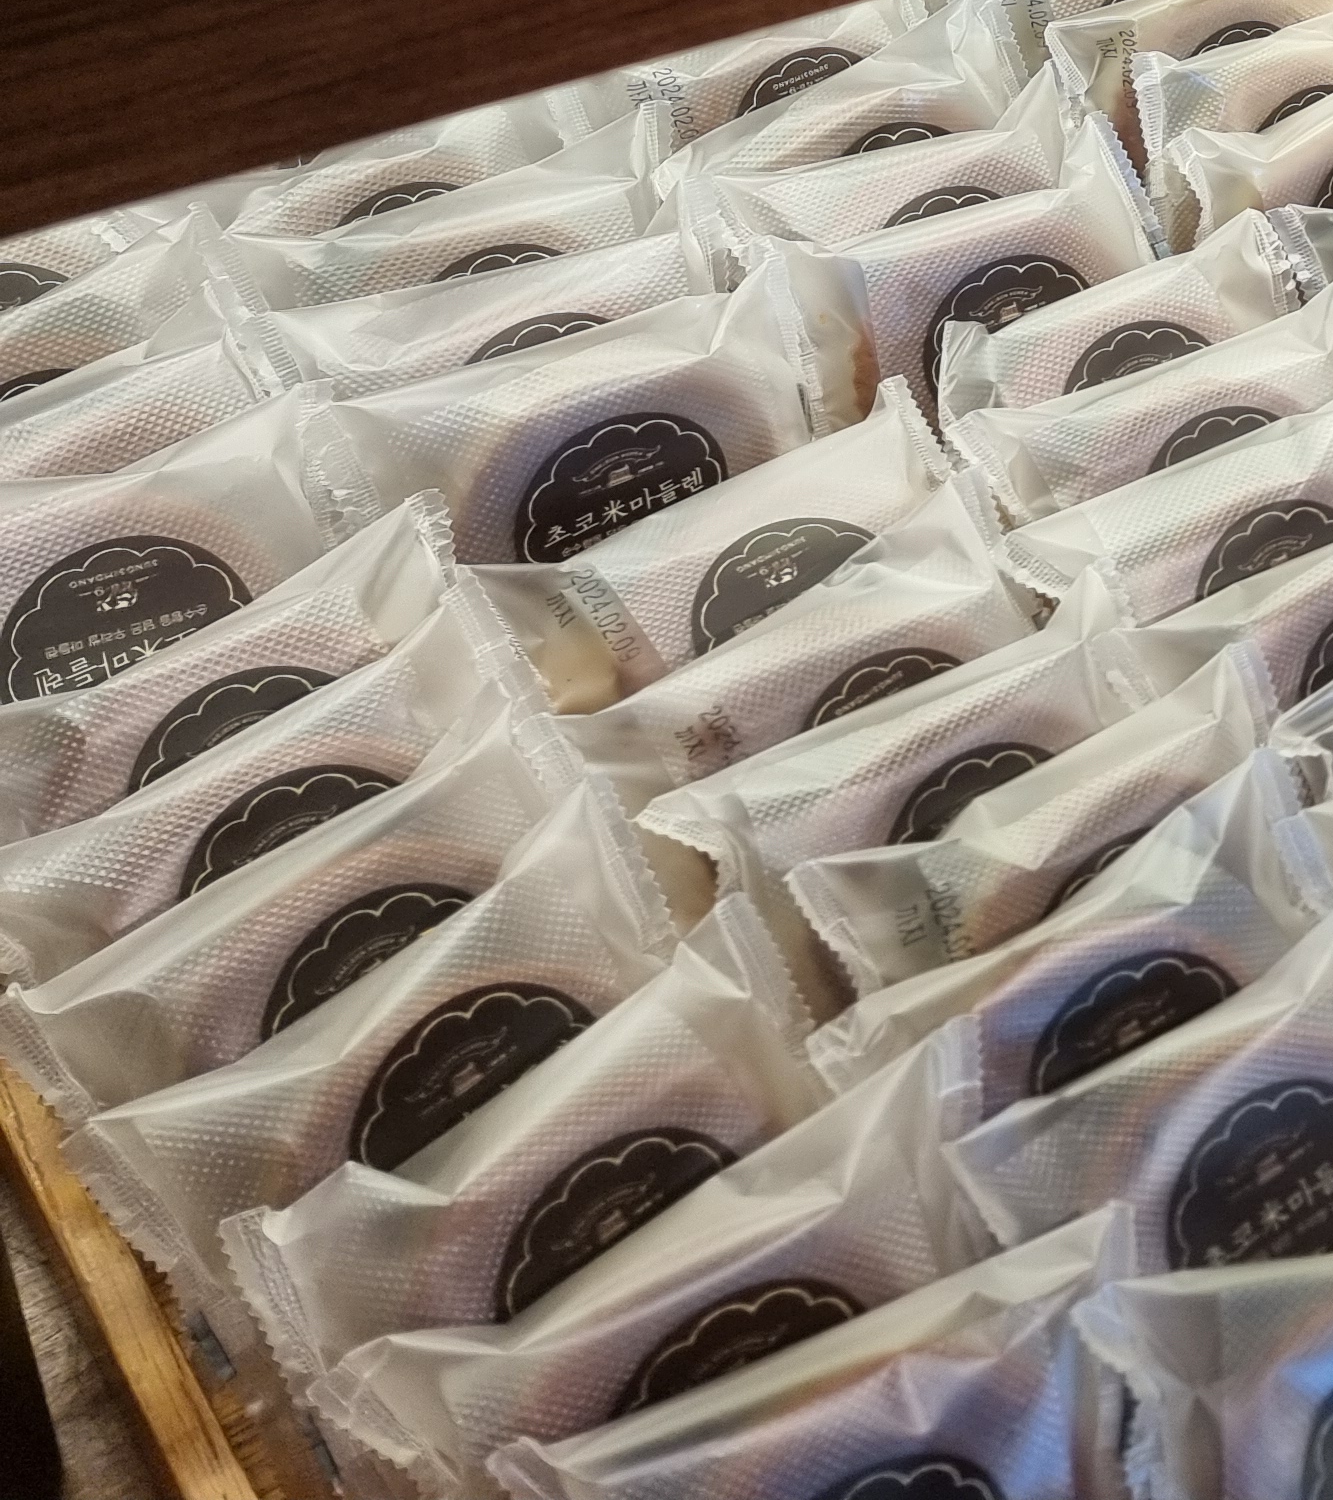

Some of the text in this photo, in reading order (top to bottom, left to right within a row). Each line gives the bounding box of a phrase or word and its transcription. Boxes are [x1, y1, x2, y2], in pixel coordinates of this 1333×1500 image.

[772, 63, 829, 91] SUNGSIMDANG
[544, 466, 705, 548] 초코米마들렌
[736, 536, 806, 573] SUNGSIMDANG
[69, 559, 158, 589] SUNGSIMDANG
[546, 591, 577, 629] 까지
[570, 568, 641, 664] 2024.02.09
[43, 603, 207, 660] 순수함을 담은 우리쌀 마들렌
